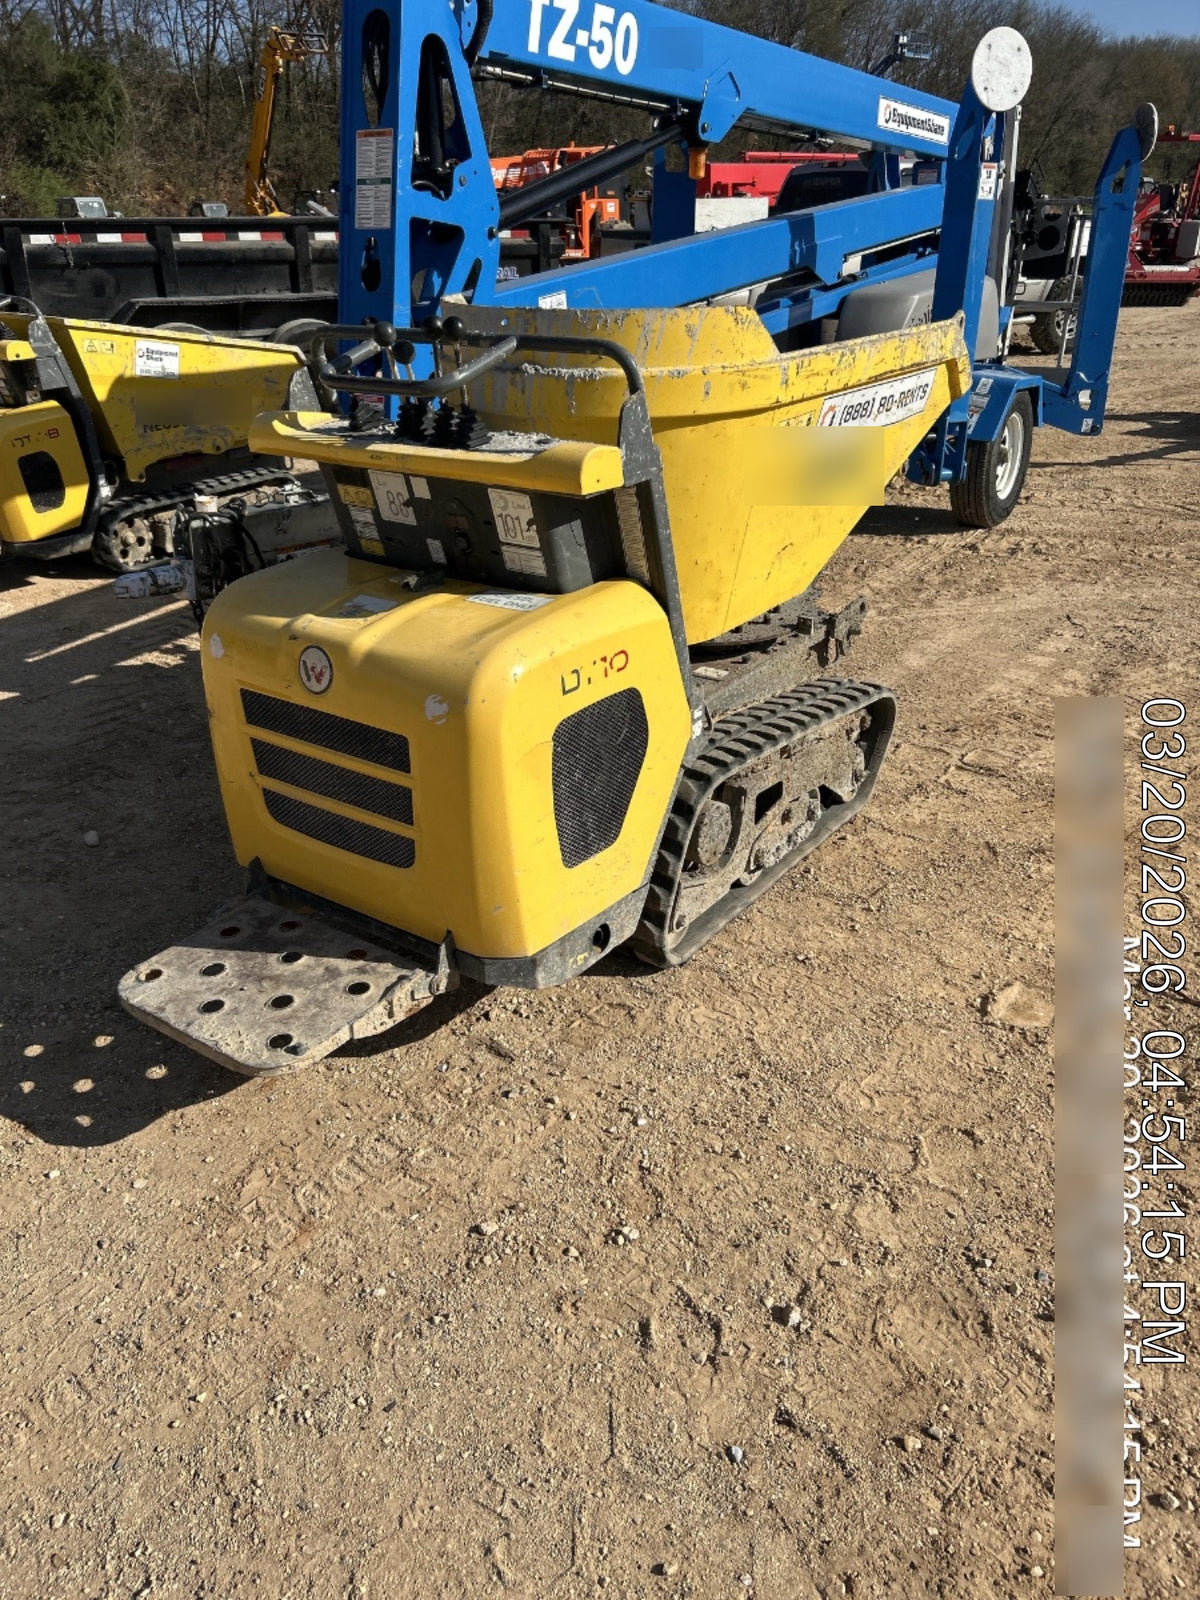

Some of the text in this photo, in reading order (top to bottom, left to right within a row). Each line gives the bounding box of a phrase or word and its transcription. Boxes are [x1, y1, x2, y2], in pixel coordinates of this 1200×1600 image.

[527, 0, 639, 76] TZ-50
[839, 383, 929, 426] (888) 80-RENTS
[496, 513, 525, 541] 101
